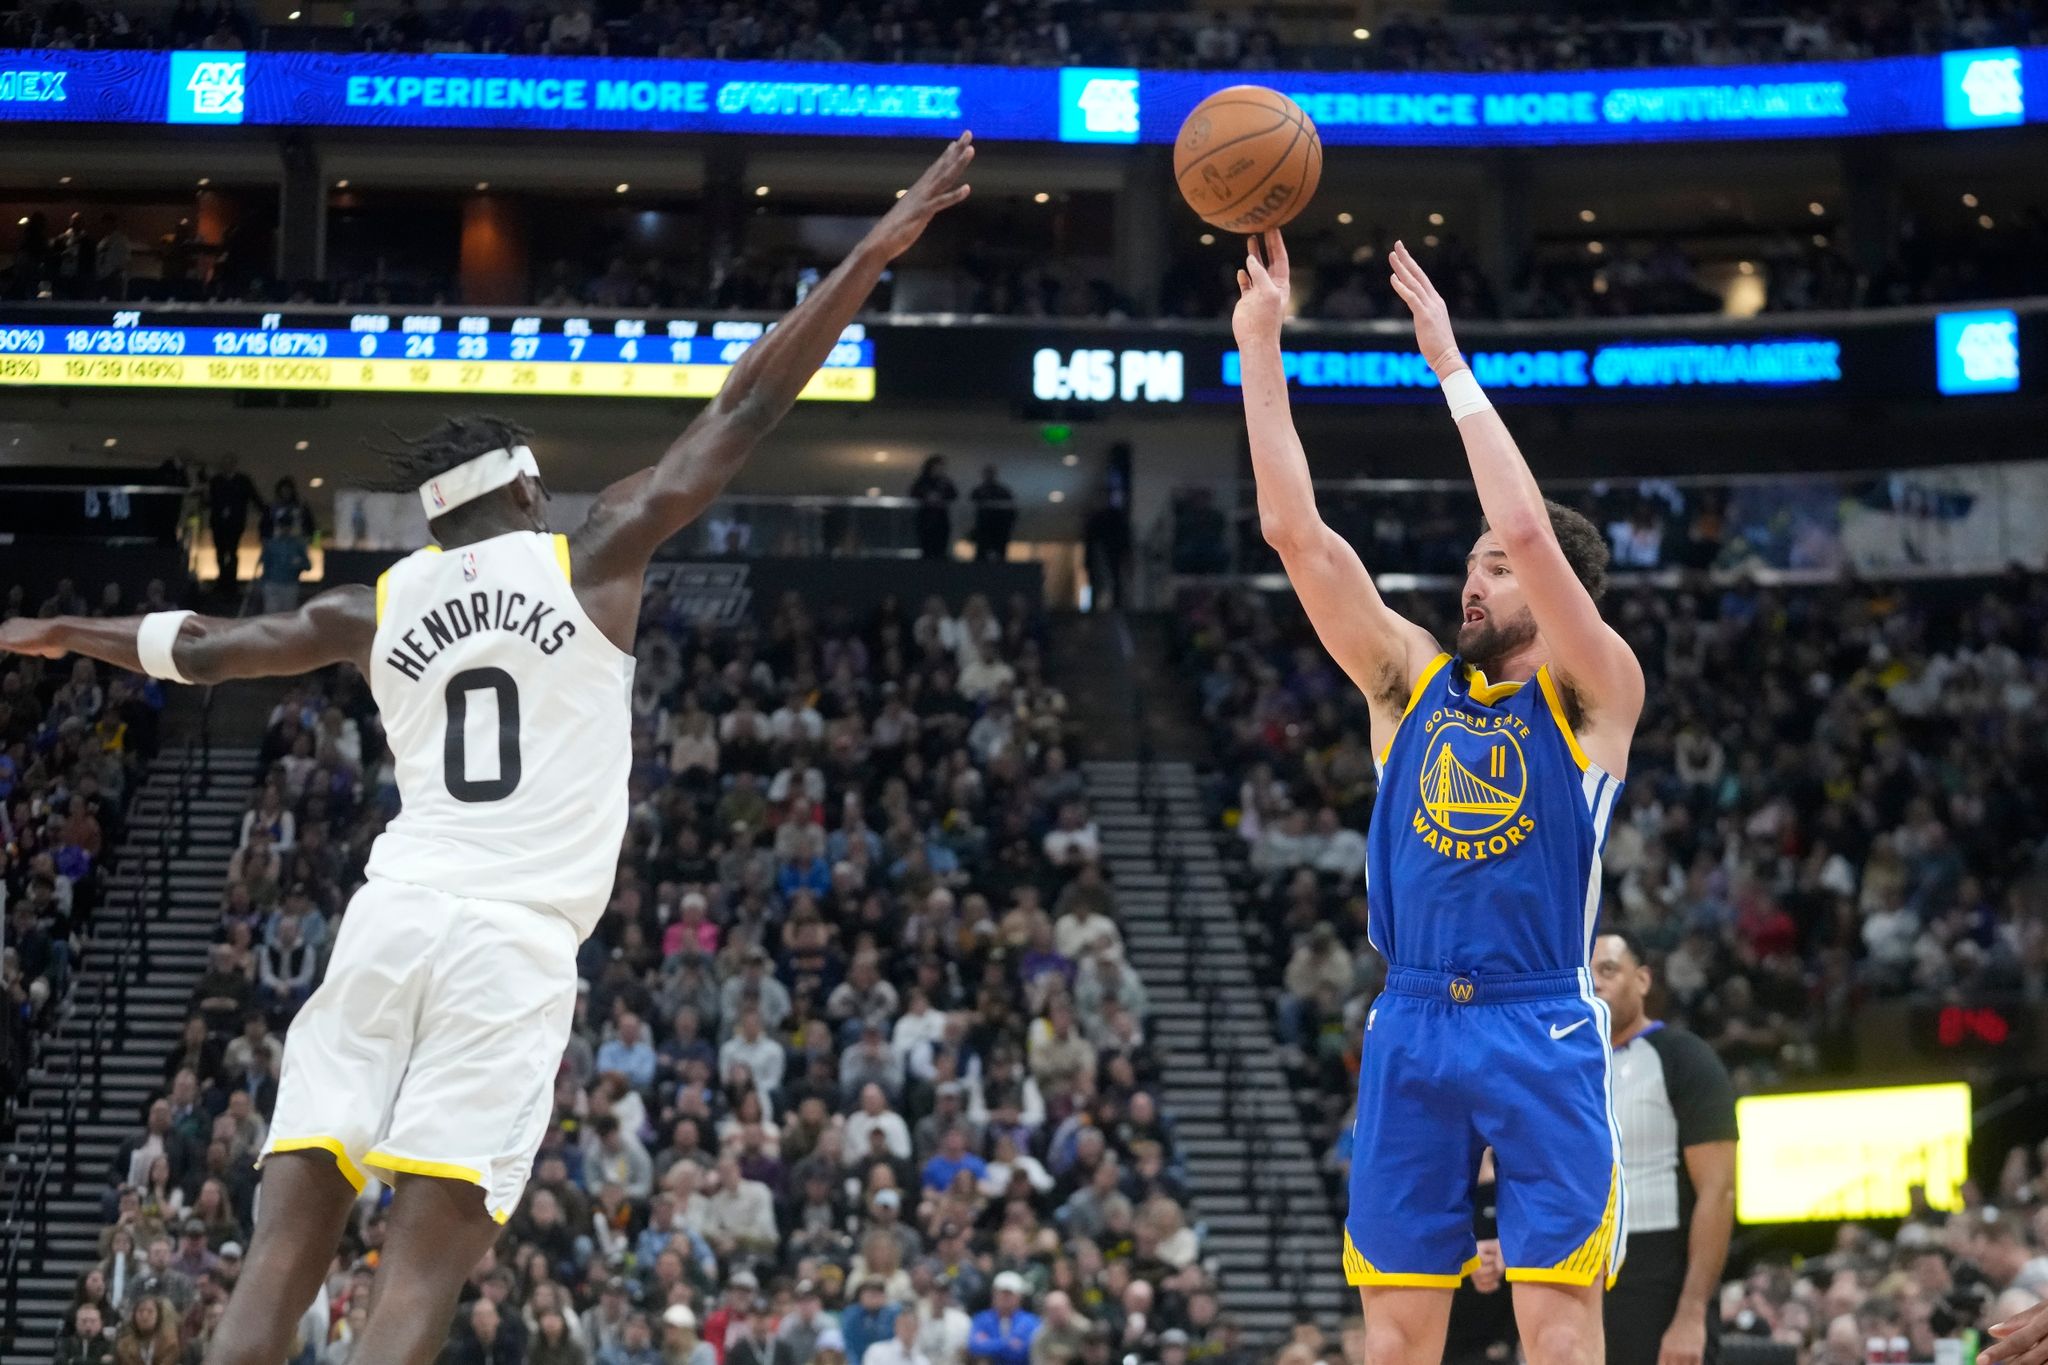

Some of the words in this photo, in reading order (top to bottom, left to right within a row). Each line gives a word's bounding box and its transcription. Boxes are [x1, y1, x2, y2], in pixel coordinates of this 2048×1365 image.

[346, 76, 587, 109] EXPERIENCE
[595, 80, 710, 112] MORE
[1483, 92, 1596, 125] MORE
[568, 338, 585, 361] 7
[619, 339, 638, 361] 4
[1120, 351, 1184, 401] PM
[1473, 351, 1588, 387] MORE
[386, 590, 576, 682] HENDRICKS
[445, 666, 521, 803] 0
[1425, 708, 1487, 733] GOLDEN
[1493, 713, 1531, 739] SATE
[1490, 745, 1505, 777] 11
[1412, 807, 1535, 860] WARRIORS
